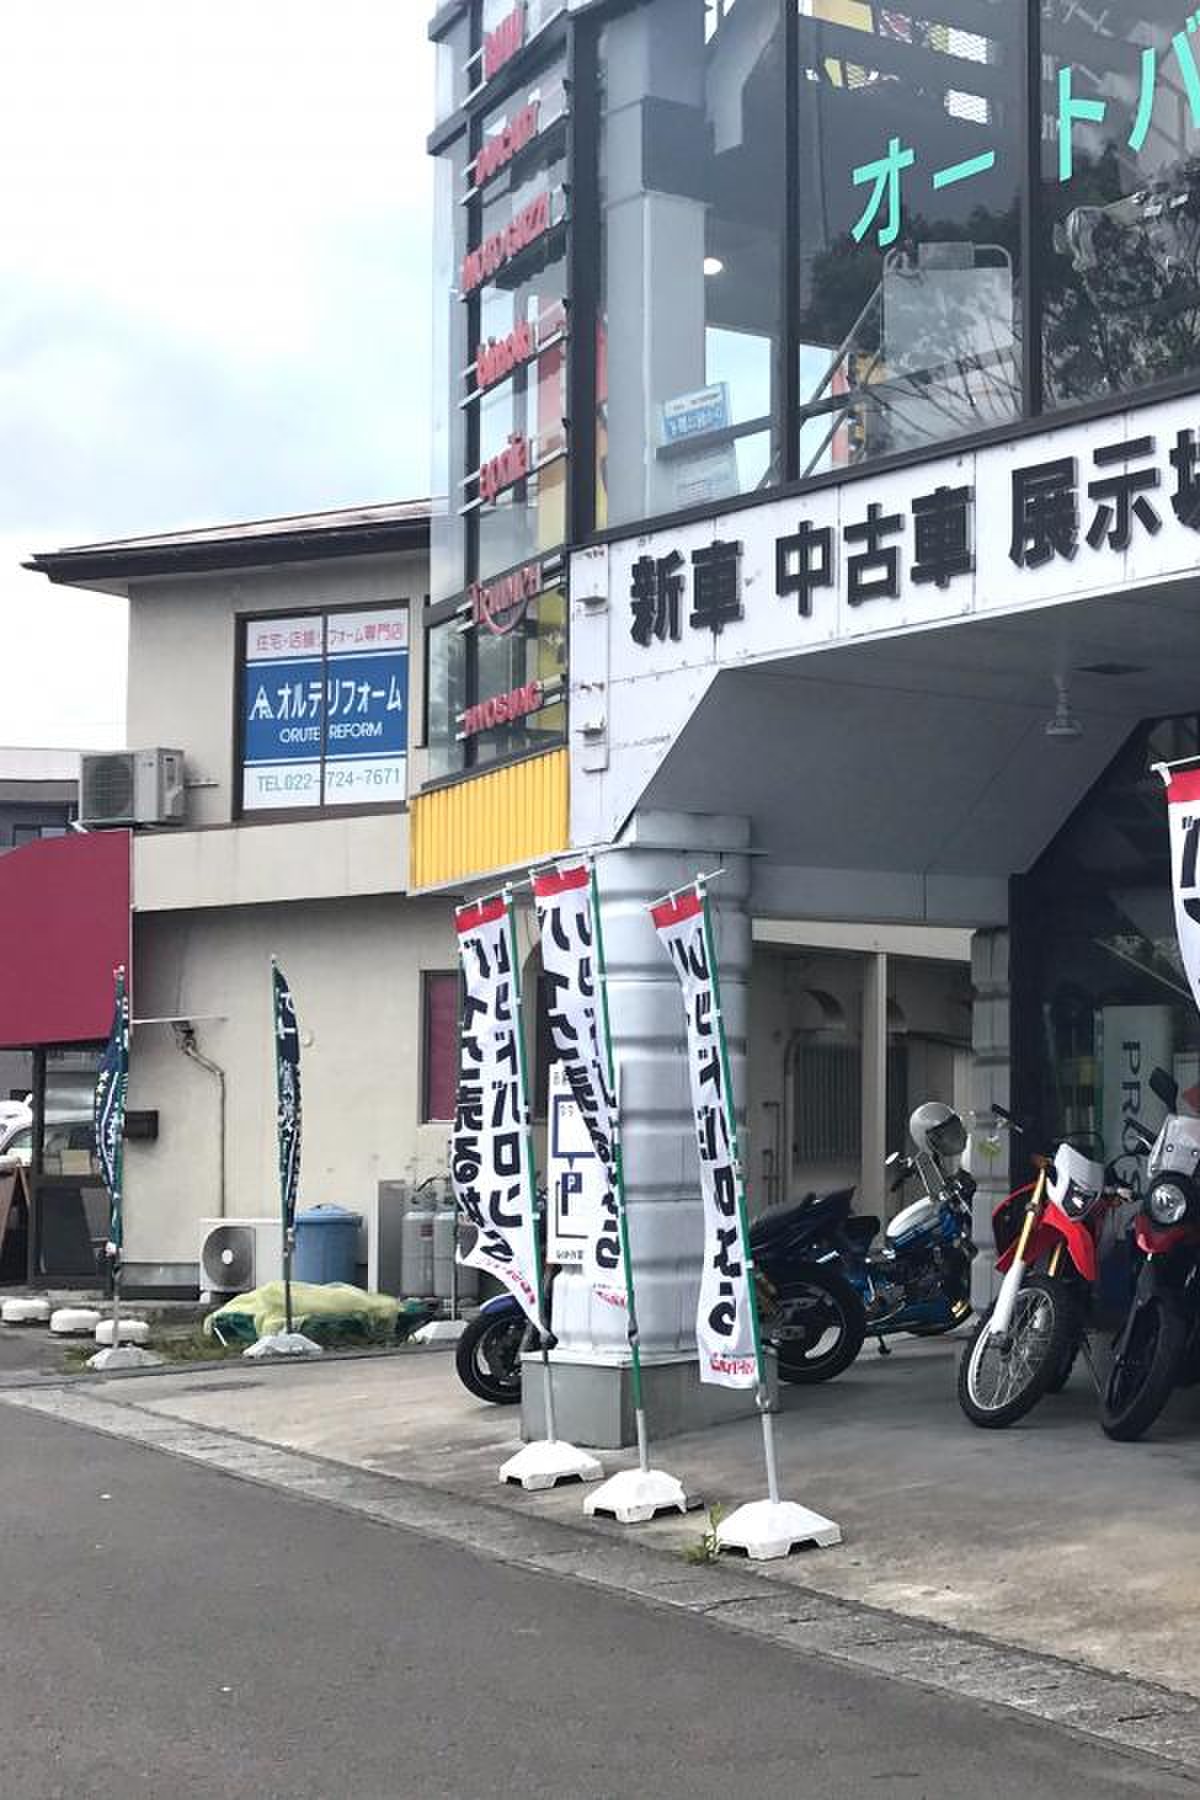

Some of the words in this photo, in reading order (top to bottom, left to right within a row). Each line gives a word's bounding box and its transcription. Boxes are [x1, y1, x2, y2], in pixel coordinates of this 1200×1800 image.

[630, 538, 745, 647] 新車
[774, 484, 976, 618] 中古車
[255, 622, 403, 652] 住宅・店舗フォーム専門店
[278, 725, 321, 744] ORUTE
[328, 720, 384, 740] REFORM
[256, 766, 401, 794] TEL022-724-7671
